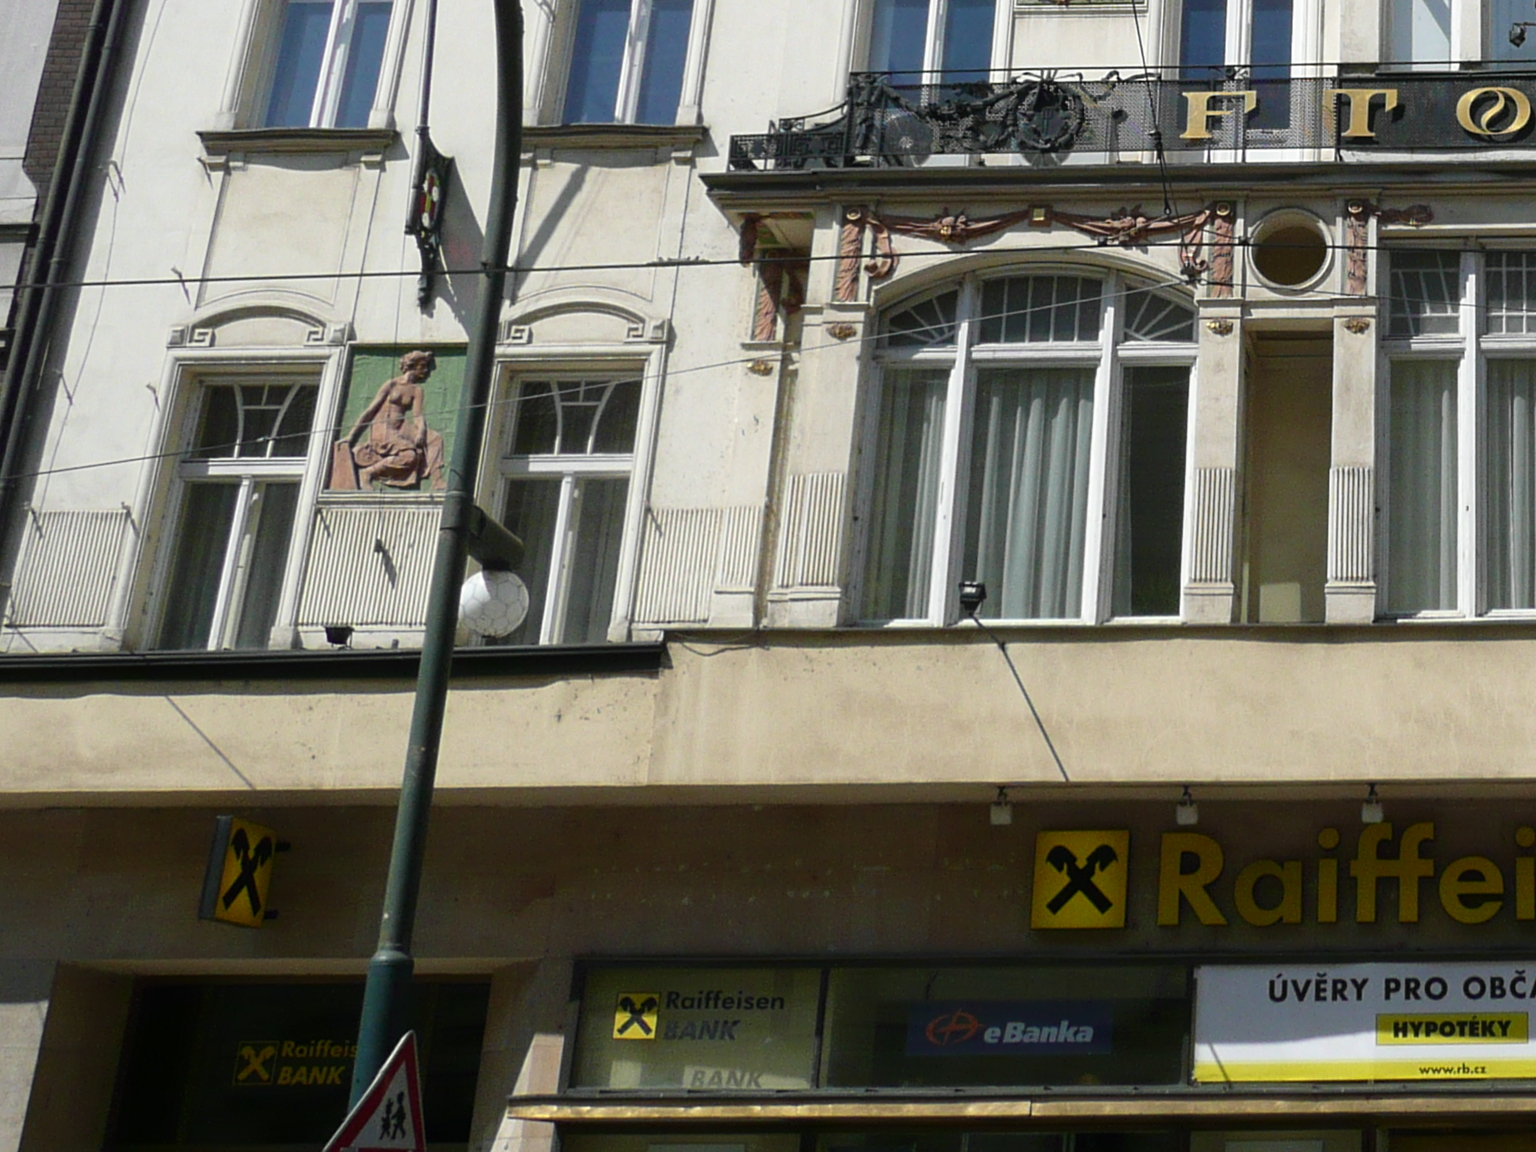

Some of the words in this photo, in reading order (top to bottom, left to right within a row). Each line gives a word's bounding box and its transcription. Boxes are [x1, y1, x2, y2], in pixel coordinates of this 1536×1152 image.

[1178, 89, 1258, 140] F
[1267, 972, 1370, 1003] ÚVĚRY
[1383, 976, 1449, 1001] PRO
[665, 989, 786, 1011] Raiffeisen
[663, 1019, 741, 1041] BANK
[984, 1019, 1095, 1044] eBanka
[1392, 1015, 1512, 1039] HYPOTÉKY
[280, 1039, 358, 1059] Raiffeis
[277, 1065, 346, 1086] BANK
[1418, 1063, 1488, 1076] www.rb.cz
